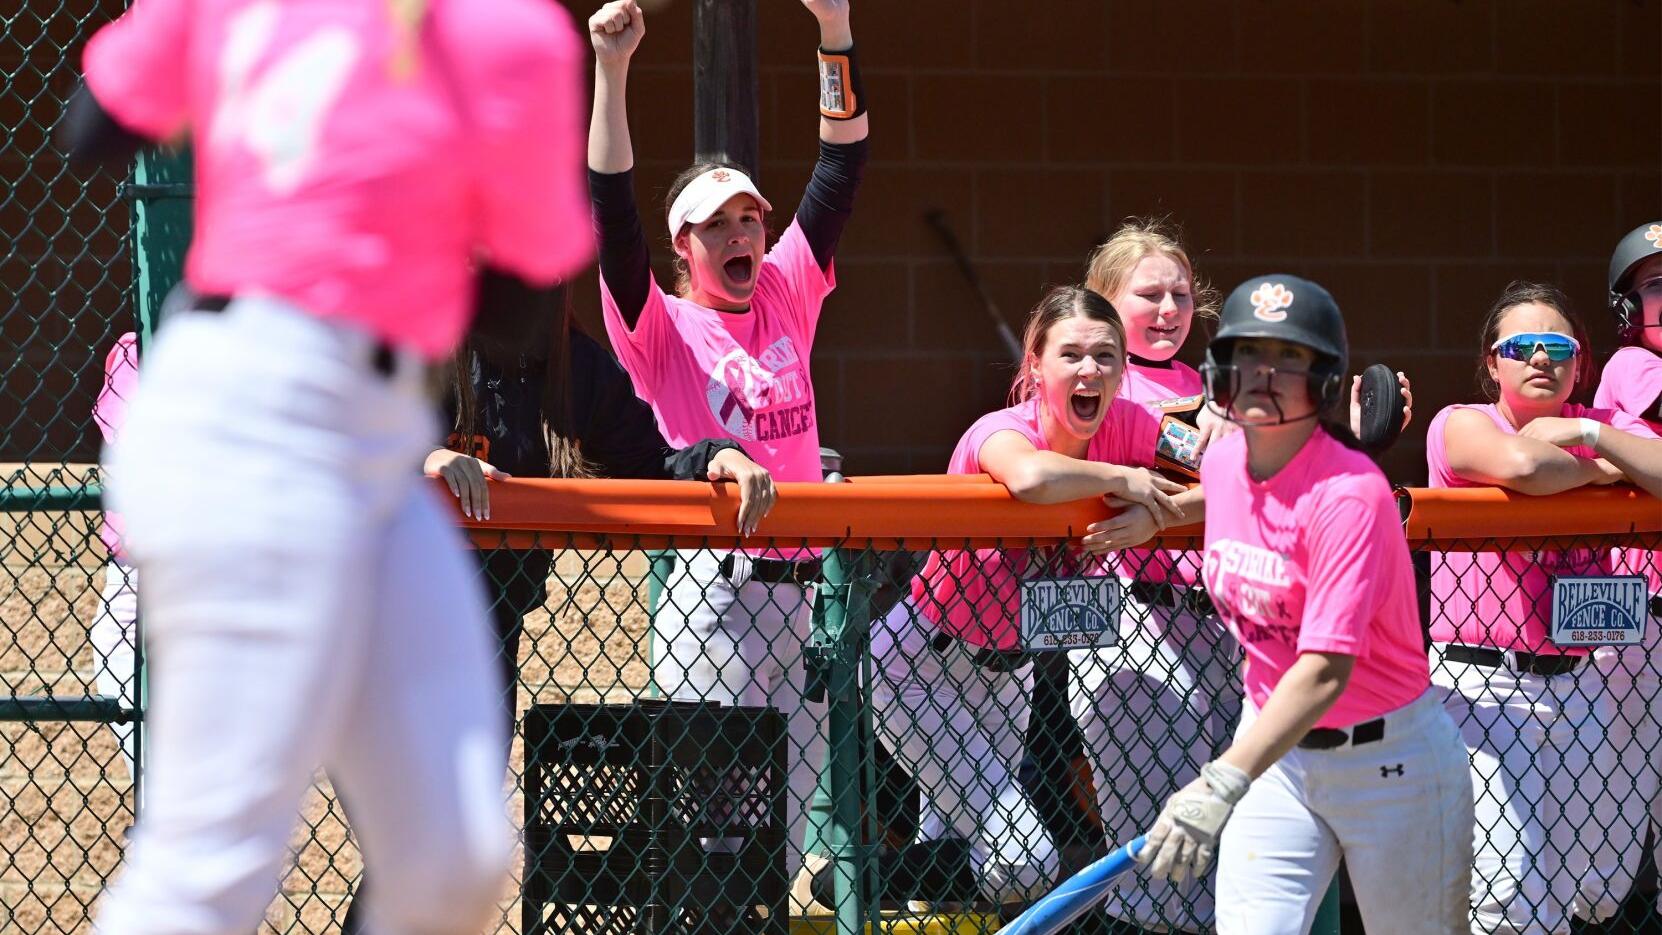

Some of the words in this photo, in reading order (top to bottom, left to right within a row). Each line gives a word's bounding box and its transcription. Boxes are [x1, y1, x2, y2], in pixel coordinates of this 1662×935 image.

[1222, 541, 1290, 587] STRIKE
[1026, 582, 1115, 639] BELLEVILLE
[1557, 582, 1642, 634] BELLEVILLE
[1571, 604, 1606, 628] FENCE
[1571, 630, 1625, 641] 618-233-0176
